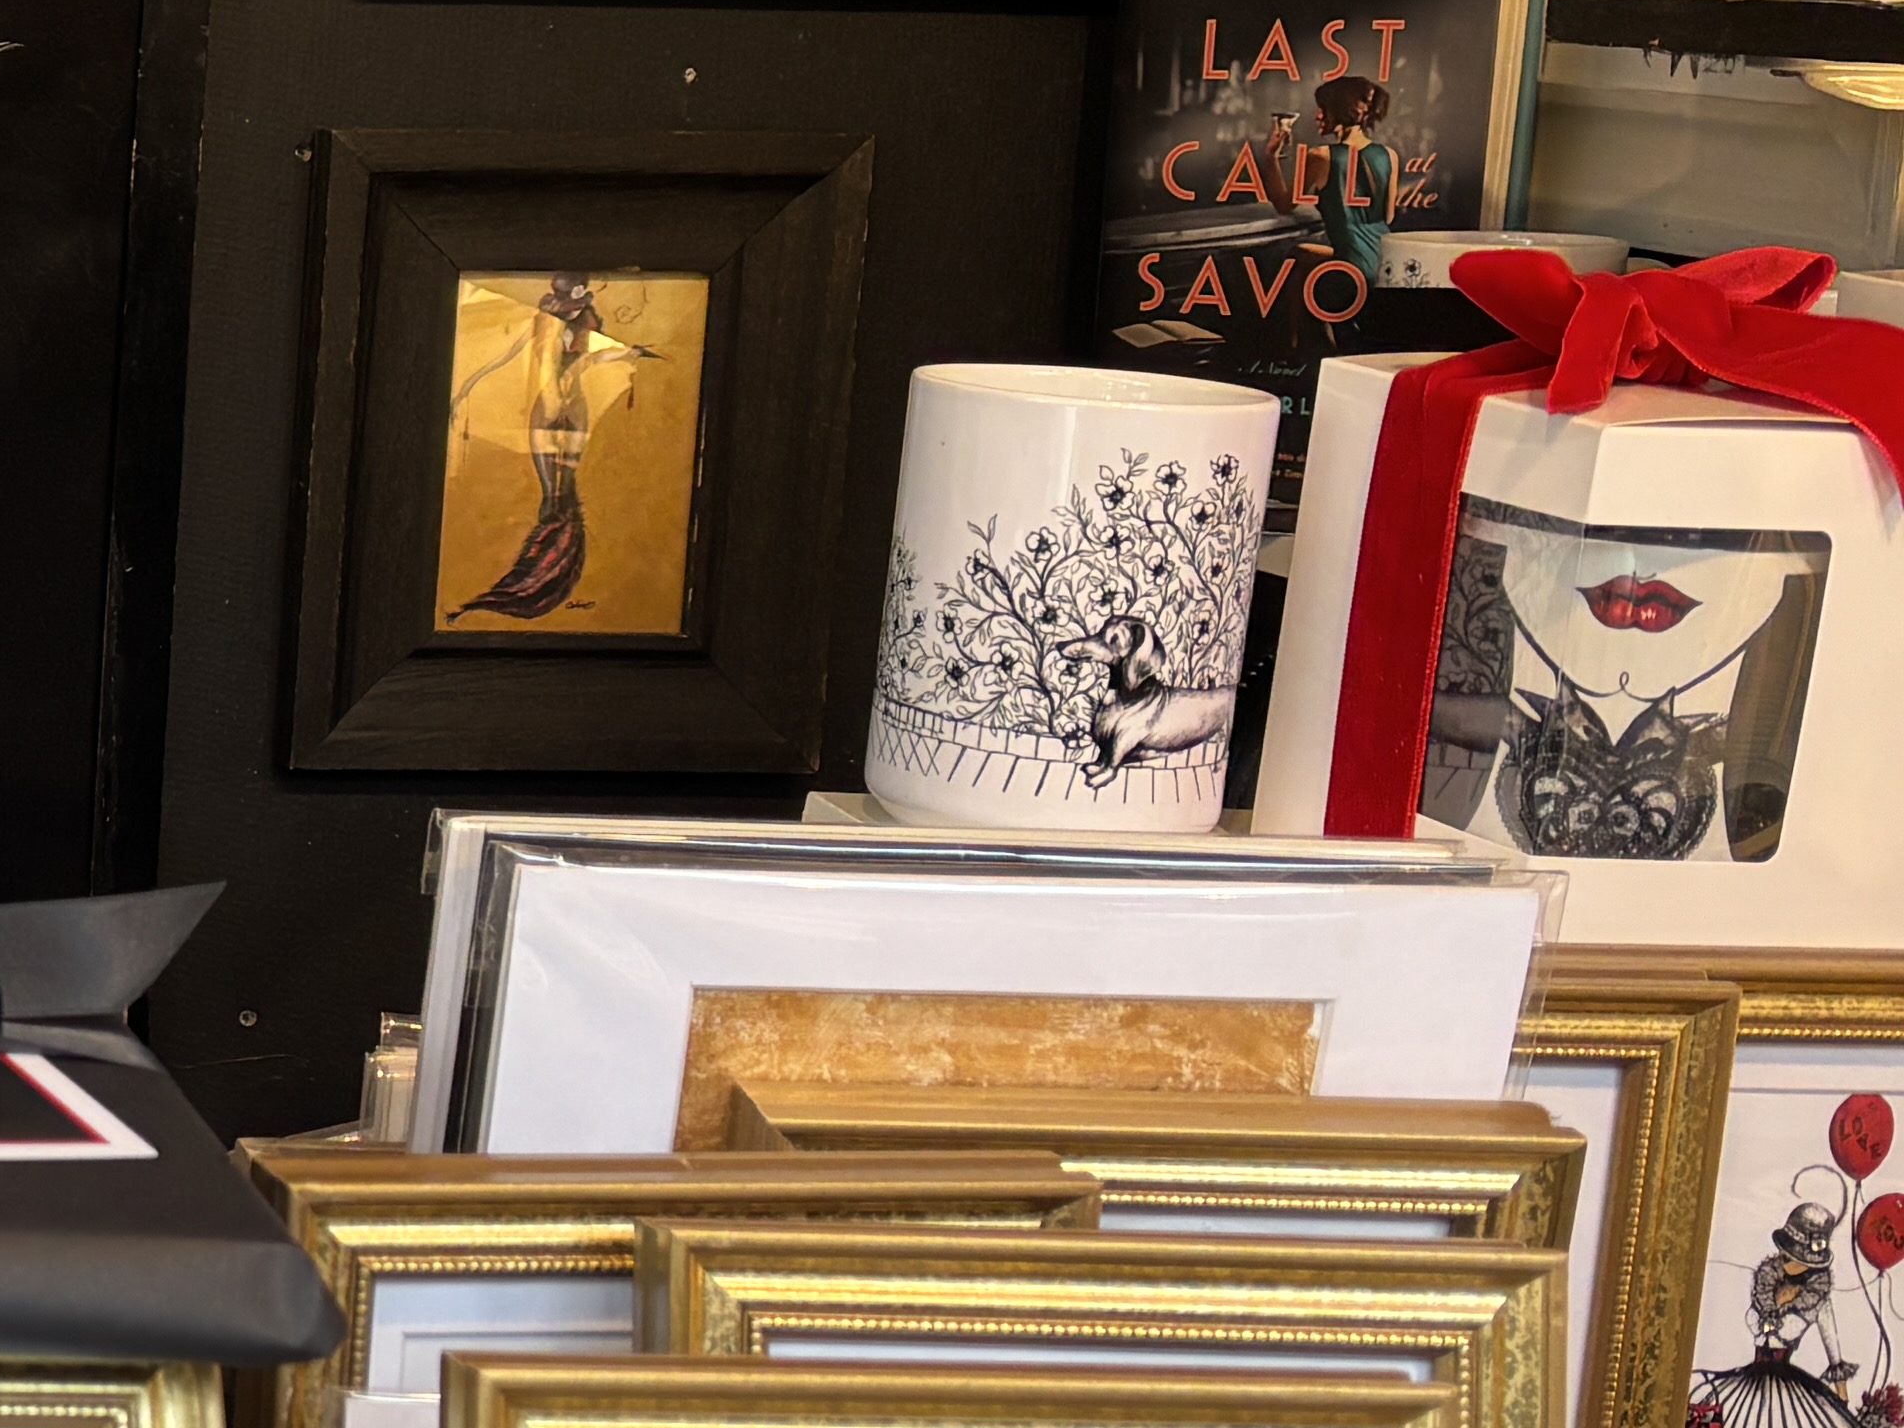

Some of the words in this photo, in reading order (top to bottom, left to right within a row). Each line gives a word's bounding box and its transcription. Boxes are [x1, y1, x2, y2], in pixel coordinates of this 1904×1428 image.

[1202, 18, 1406, 83] LAST
[1161, 141, 1372, 208] CALL
[1404, 151, 1438, 174] at
[1395, 178, 1439, 209] the
[1137, 251, 1368, 323] SAVO
